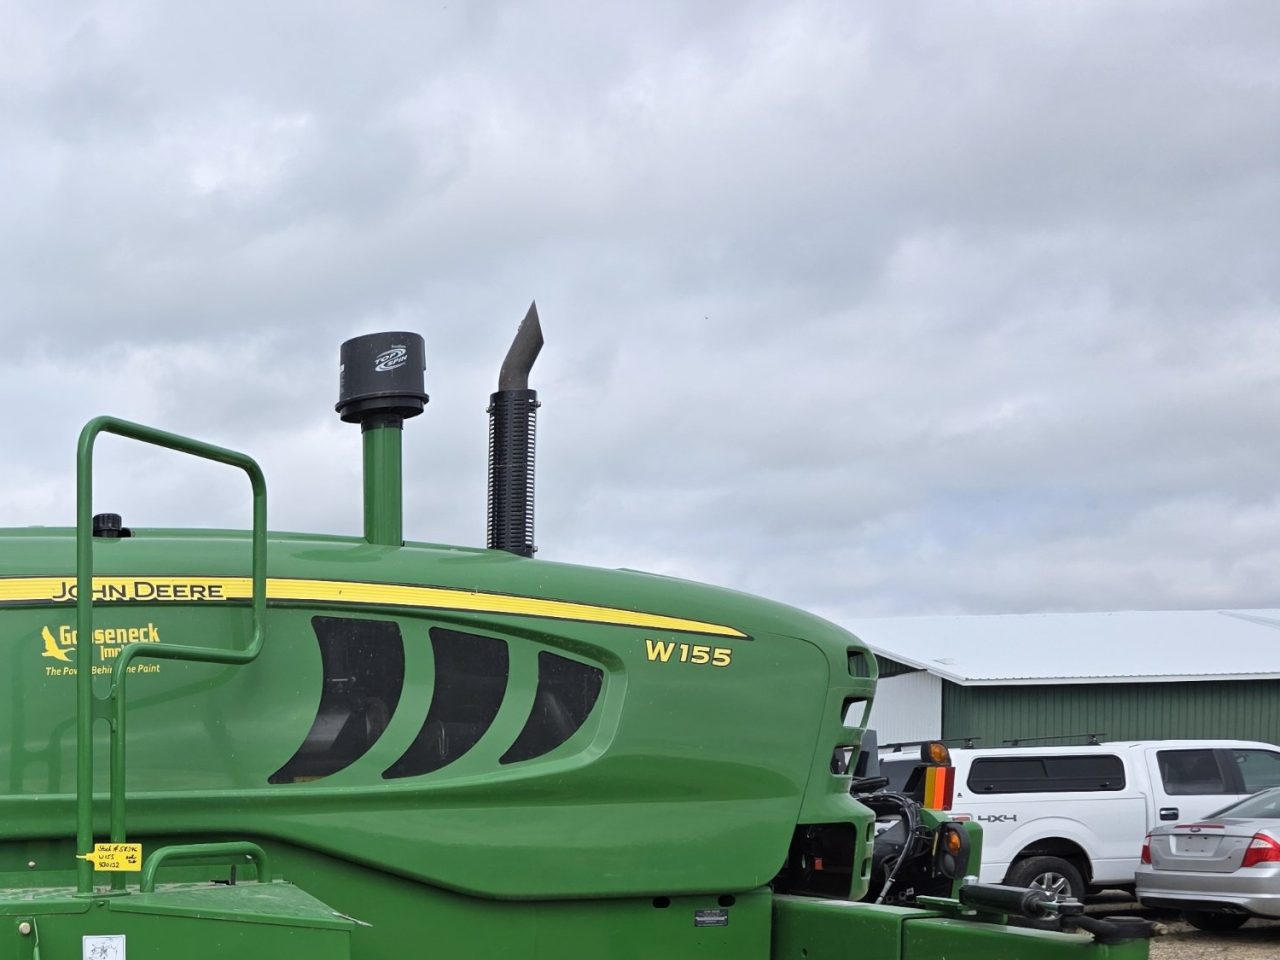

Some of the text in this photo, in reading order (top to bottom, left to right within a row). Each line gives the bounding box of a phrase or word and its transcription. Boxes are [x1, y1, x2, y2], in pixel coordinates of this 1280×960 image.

[133, 581, 223, 599] DEERE
[59, 623, 161, 645] Goseneck
[645, 639, 733, 668] W155
[46, 666, 61, 676] The
[138, 664, 160, 673] Paint
